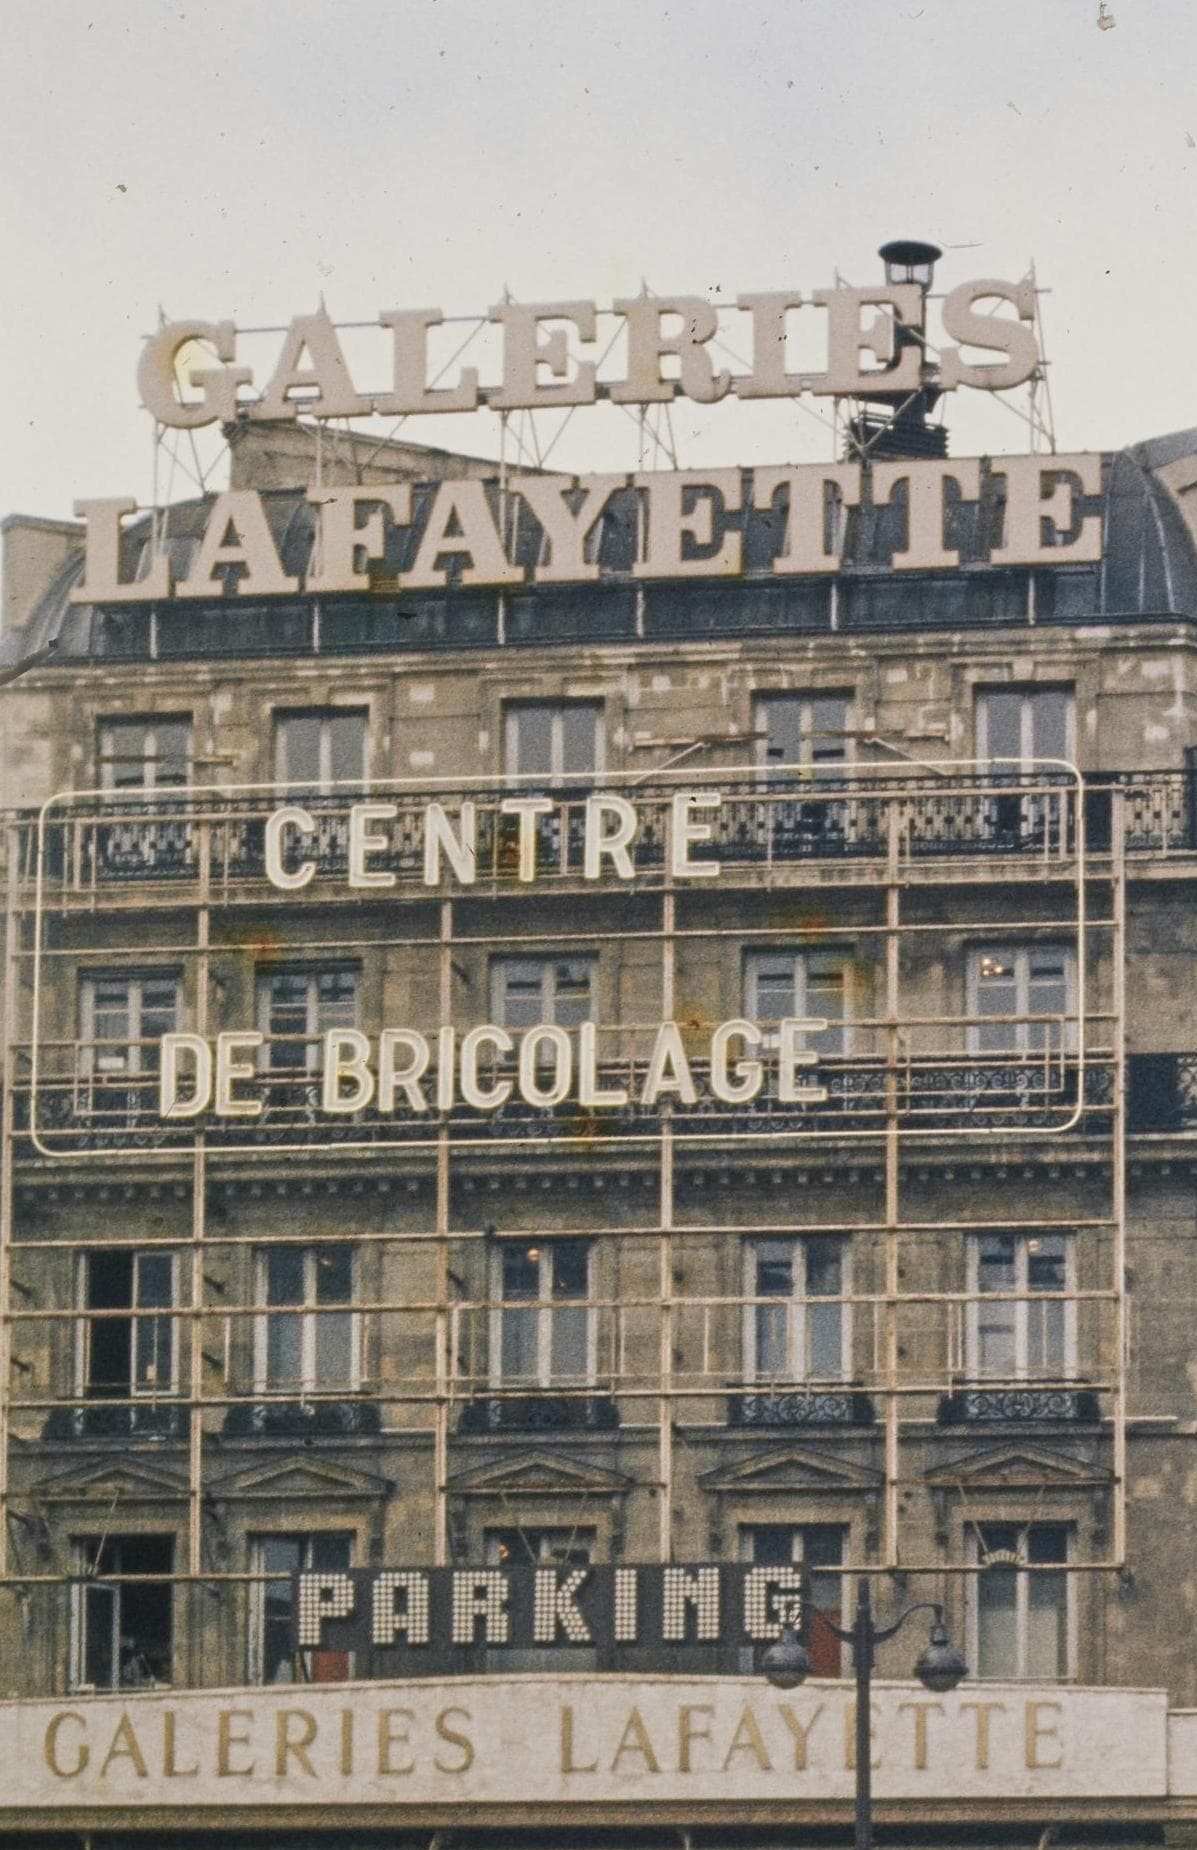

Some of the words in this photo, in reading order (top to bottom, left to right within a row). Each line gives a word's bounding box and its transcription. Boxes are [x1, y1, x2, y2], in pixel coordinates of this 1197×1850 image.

[137, 277, 1042, 430] GALERIES
[72, 452, 1104, 600] LAFAYETTE
[265, 792, 722, 889] CENTRE
[160, 1031, 263, 1119] DE
[321, 1017, 830, 1114] BRICOLAGE
[297, 1566, 802, 1646] PARKING
[44, 1705, 478, 1780] GALERIES
[559, 1700, 1065, 1775] LAFAYETTE
